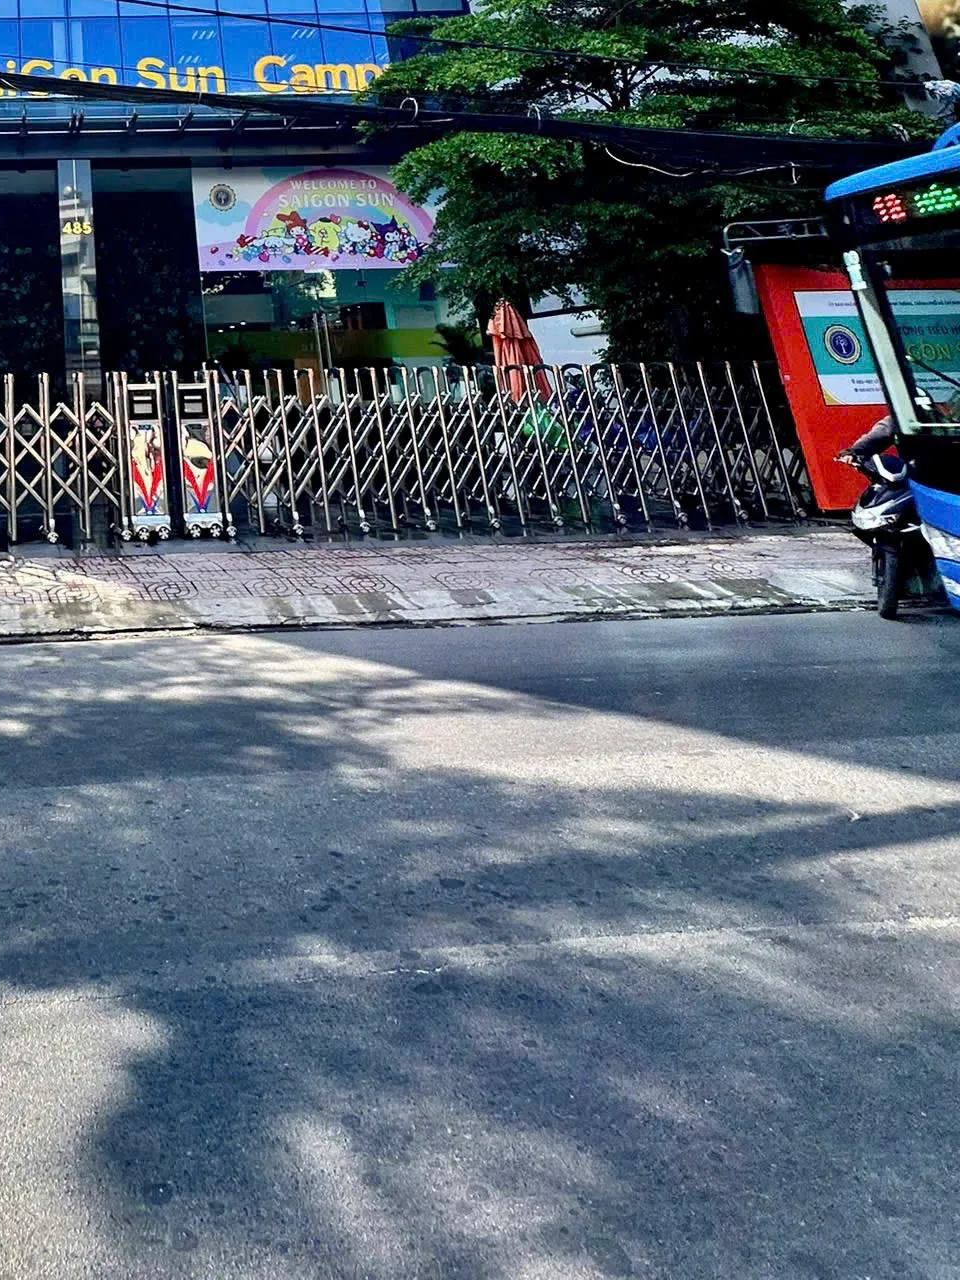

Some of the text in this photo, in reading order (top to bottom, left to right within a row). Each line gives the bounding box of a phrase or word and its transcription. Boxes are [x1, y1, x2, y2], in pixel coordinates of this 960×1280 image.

[136, 56, 226, 94] Sun
[289, 179, 377, 191] WELCOME TO
[278, 192, 394, 209] SAIGON SUN
[62, 221, 92, 235] 485
